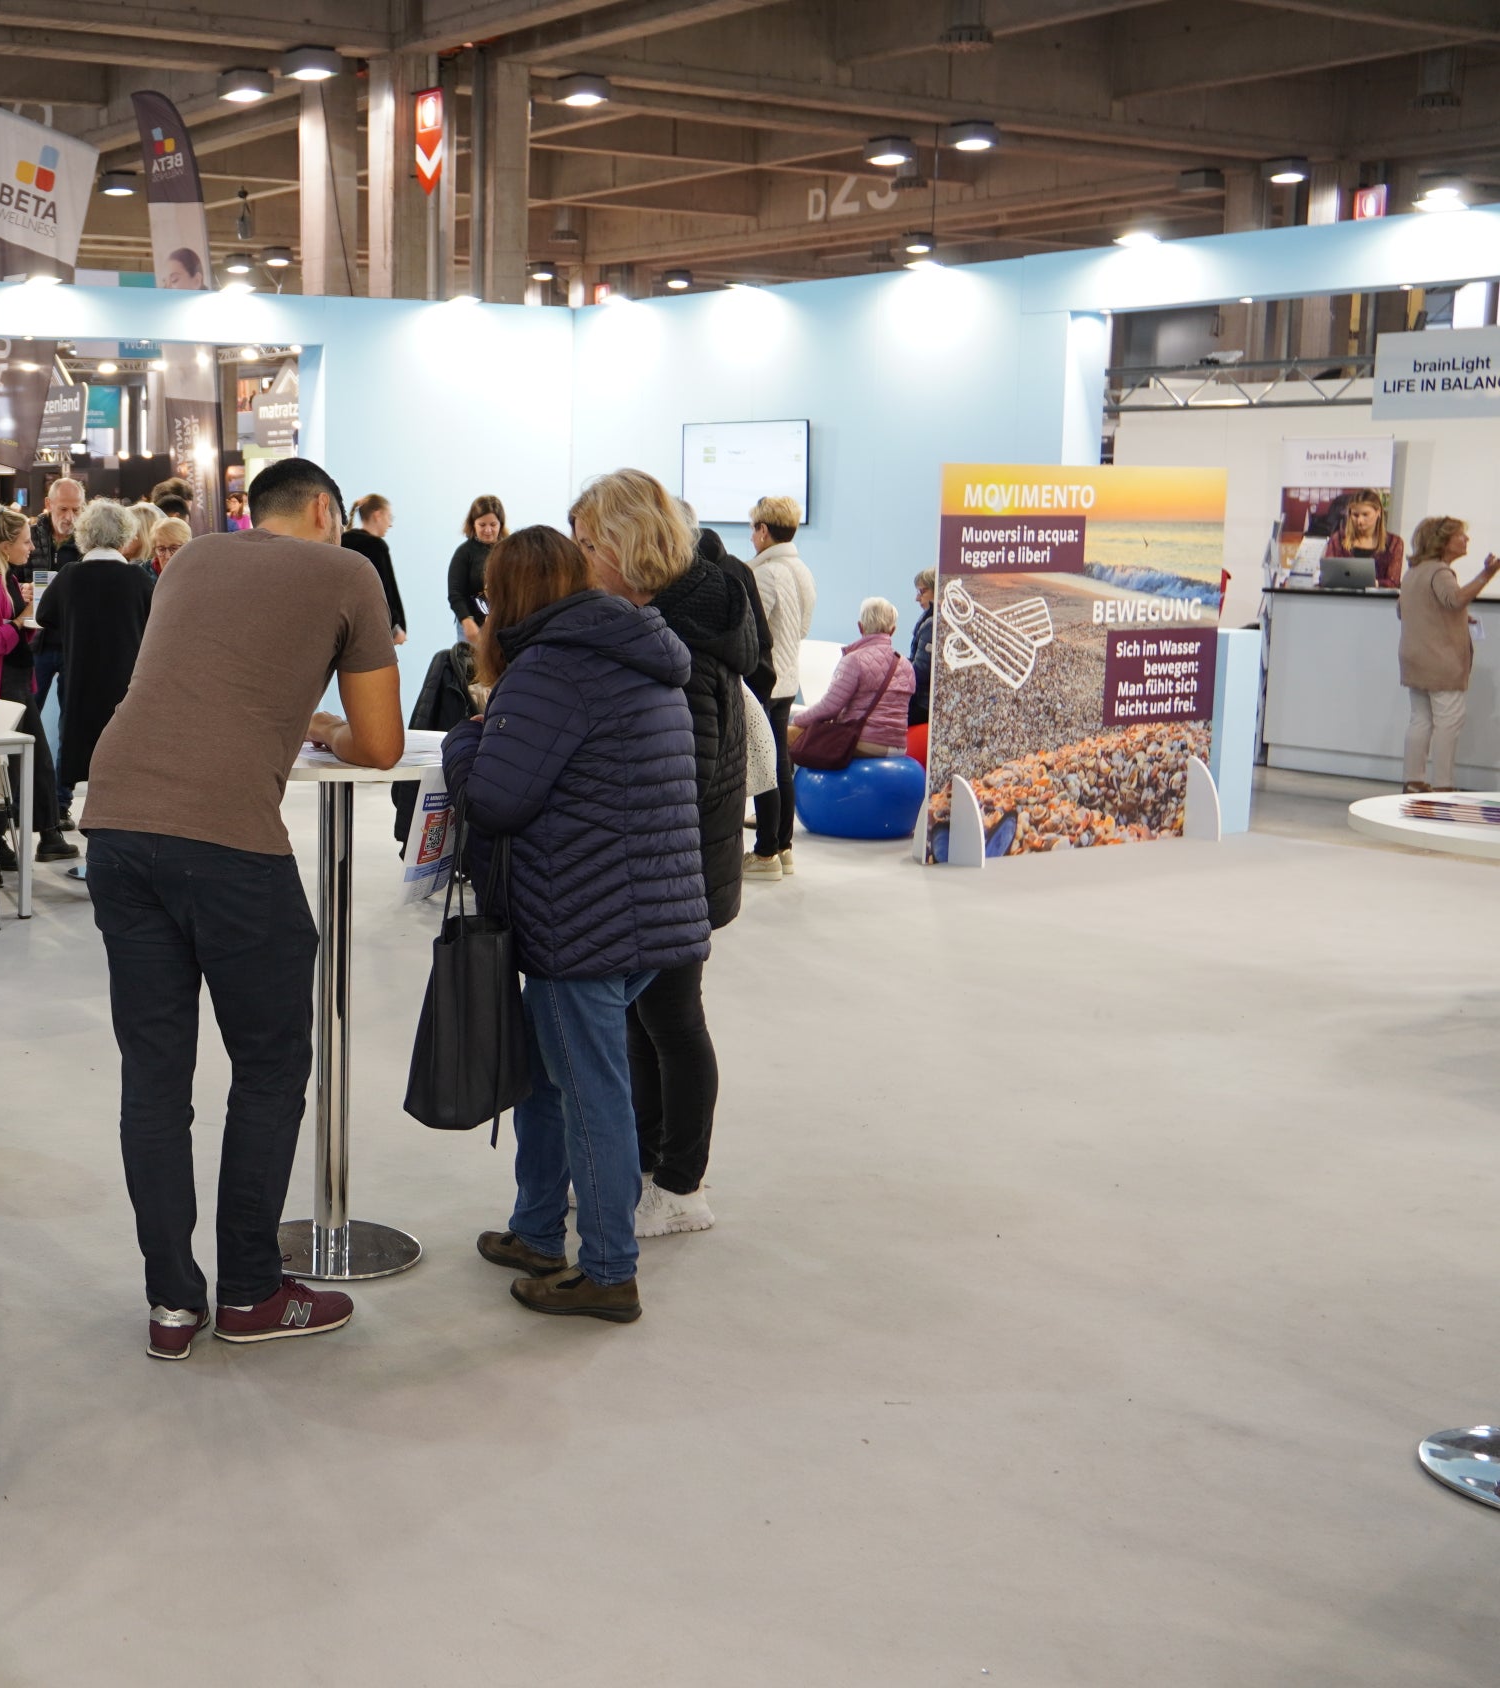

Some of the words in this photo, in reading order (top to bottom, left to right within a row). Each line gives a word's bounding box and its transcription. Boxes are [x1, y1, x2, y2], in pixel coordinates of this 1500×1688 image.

[0, 183, 58, 225] BETA
[1413, 356, 1491, 373] brainLight
[1383, 379, 1416, 394] LIFE
[1421, 378, 1436, 392] IN
[1441, 375, 1500, 391] BALAN
[1306, 450, 1367, 463] brainLight
[963, 483, 1096, 509] MOVIMENTO
[961, 525, 1022, 544] Muoversi
[1023, 526, 1037, 543] in
[1037, 528, 1079, 547] acqua:
[960, 547, 1006, 568] leggeri
[1008, 551, 1016, 564] e
[1017, 546, 1051, 564] liberi
[1092, 598, 1202, 624] BEWEGUNG
[1115, 640, 1140, 658] Sich
[1142, 639, 1157, 657] im
[1159, 640, 1201, 656] Wasser
[1143, 659, 1199, 678] bewegen:
[1117, 681, 1144, 698] Man
[1145, 678, 1174, 695] fühlt
[1175, 676, 1198, 693] sich
[1114, 700, 1148, 717] leicht
[1150, 697, 1172, 714] und
[1173, 695, 1196, 713] frei.
[280, 1300, 313, 1328] N
